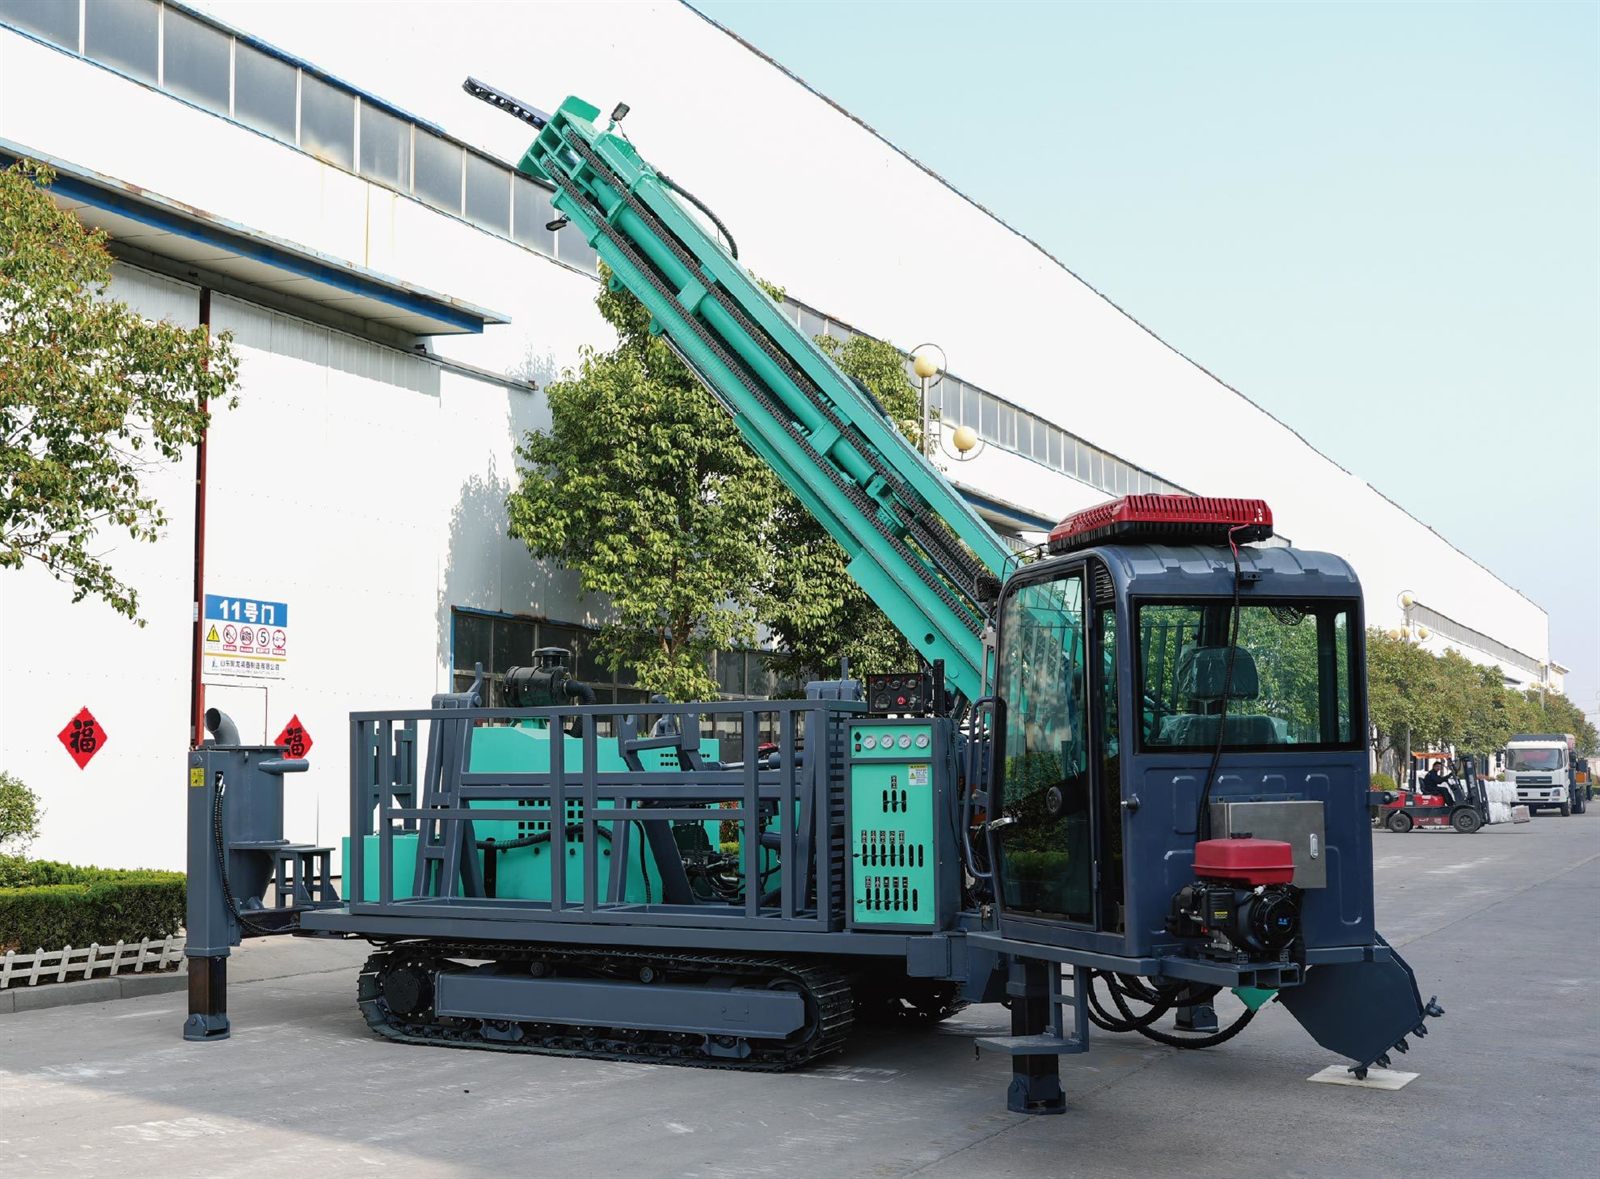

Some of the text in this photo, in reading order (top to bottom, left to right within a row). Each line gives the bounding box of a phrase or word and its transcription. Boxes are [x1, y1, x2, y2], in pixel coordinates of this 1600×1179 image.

[220, 600, 274, 624] 11号门
[260, 631, 266, 644] 5
[70, 720, 96, 753] 福
[284, 727, 304, 756] 福
